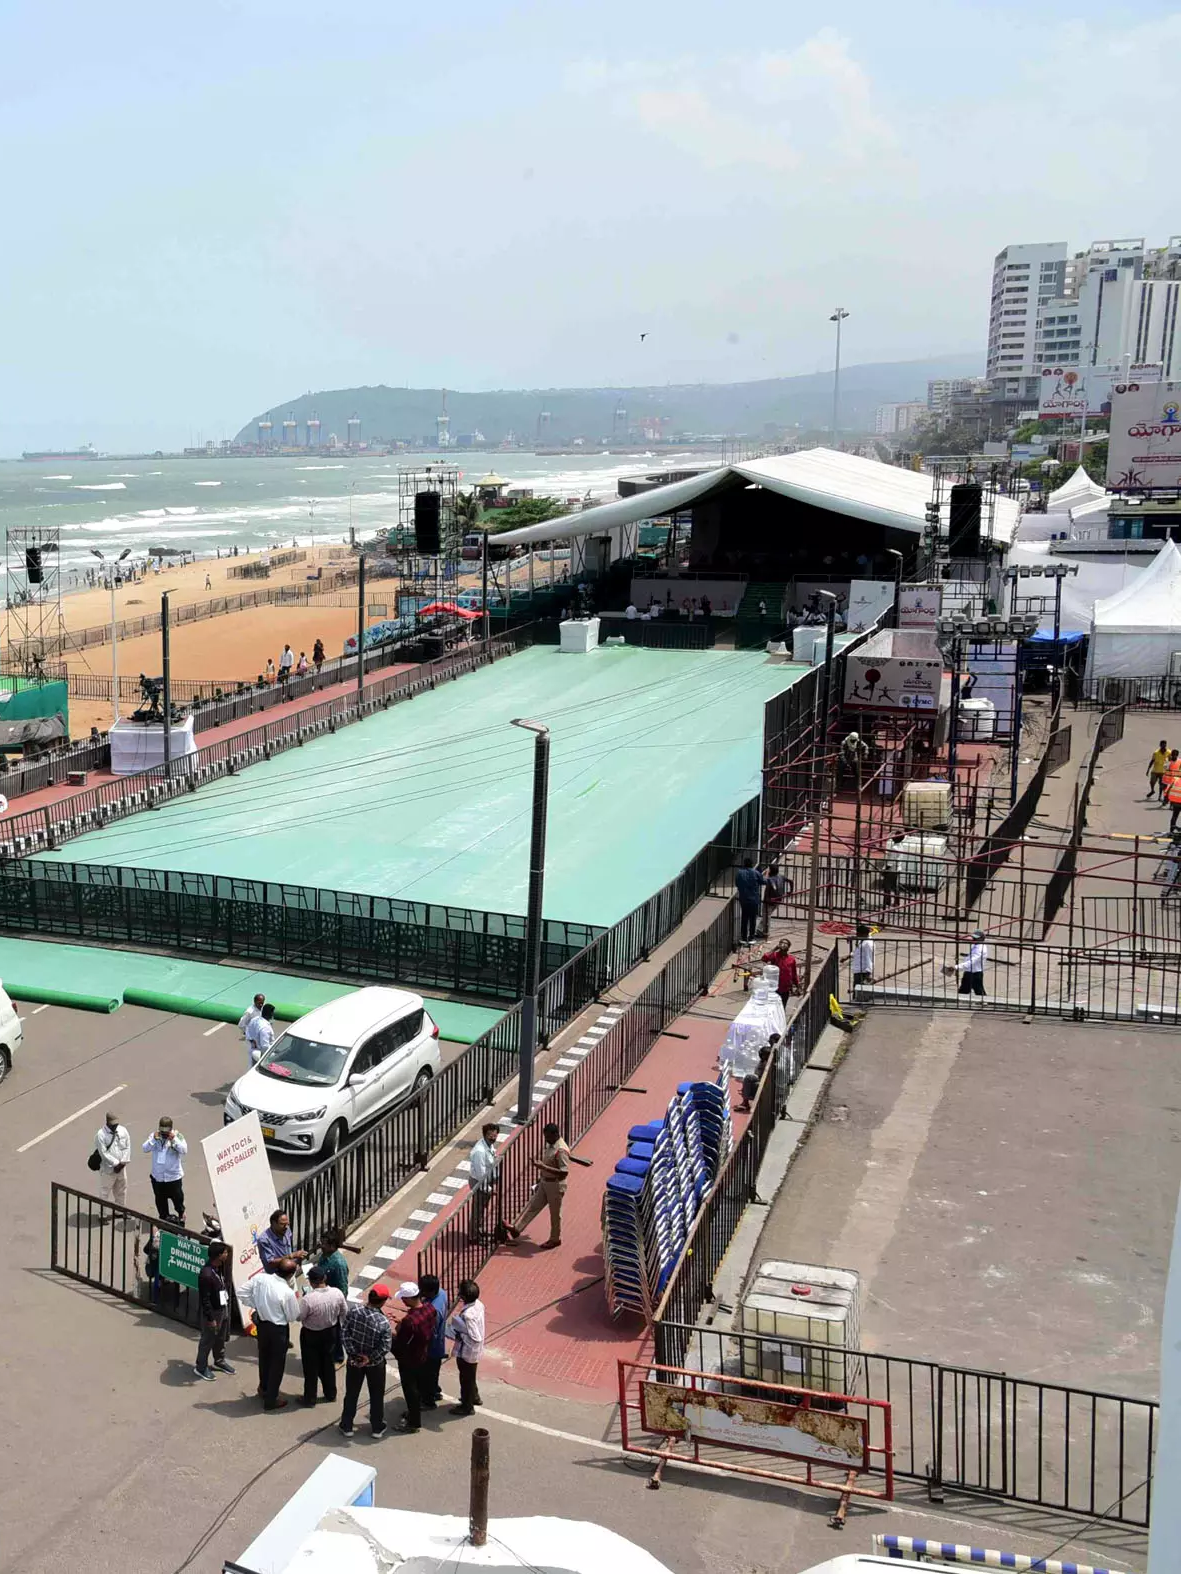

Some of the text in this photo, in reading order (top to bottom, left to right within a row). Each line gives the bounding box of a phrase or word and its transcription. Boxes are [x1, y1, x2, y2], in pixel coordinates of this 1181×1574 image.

[216, 1146, 231, 1161] WAY
[231, 1142, 240, 1152] TO
[239, 1137, 248, 1148] C1
[216, 1144, 258, 1175] PRESS GALLERY
[170, 1247, 206, 1266] DRINKING
[178, 1240, 201, 1255] WAY TO
[176, 1259, 201, 1274] WATER
